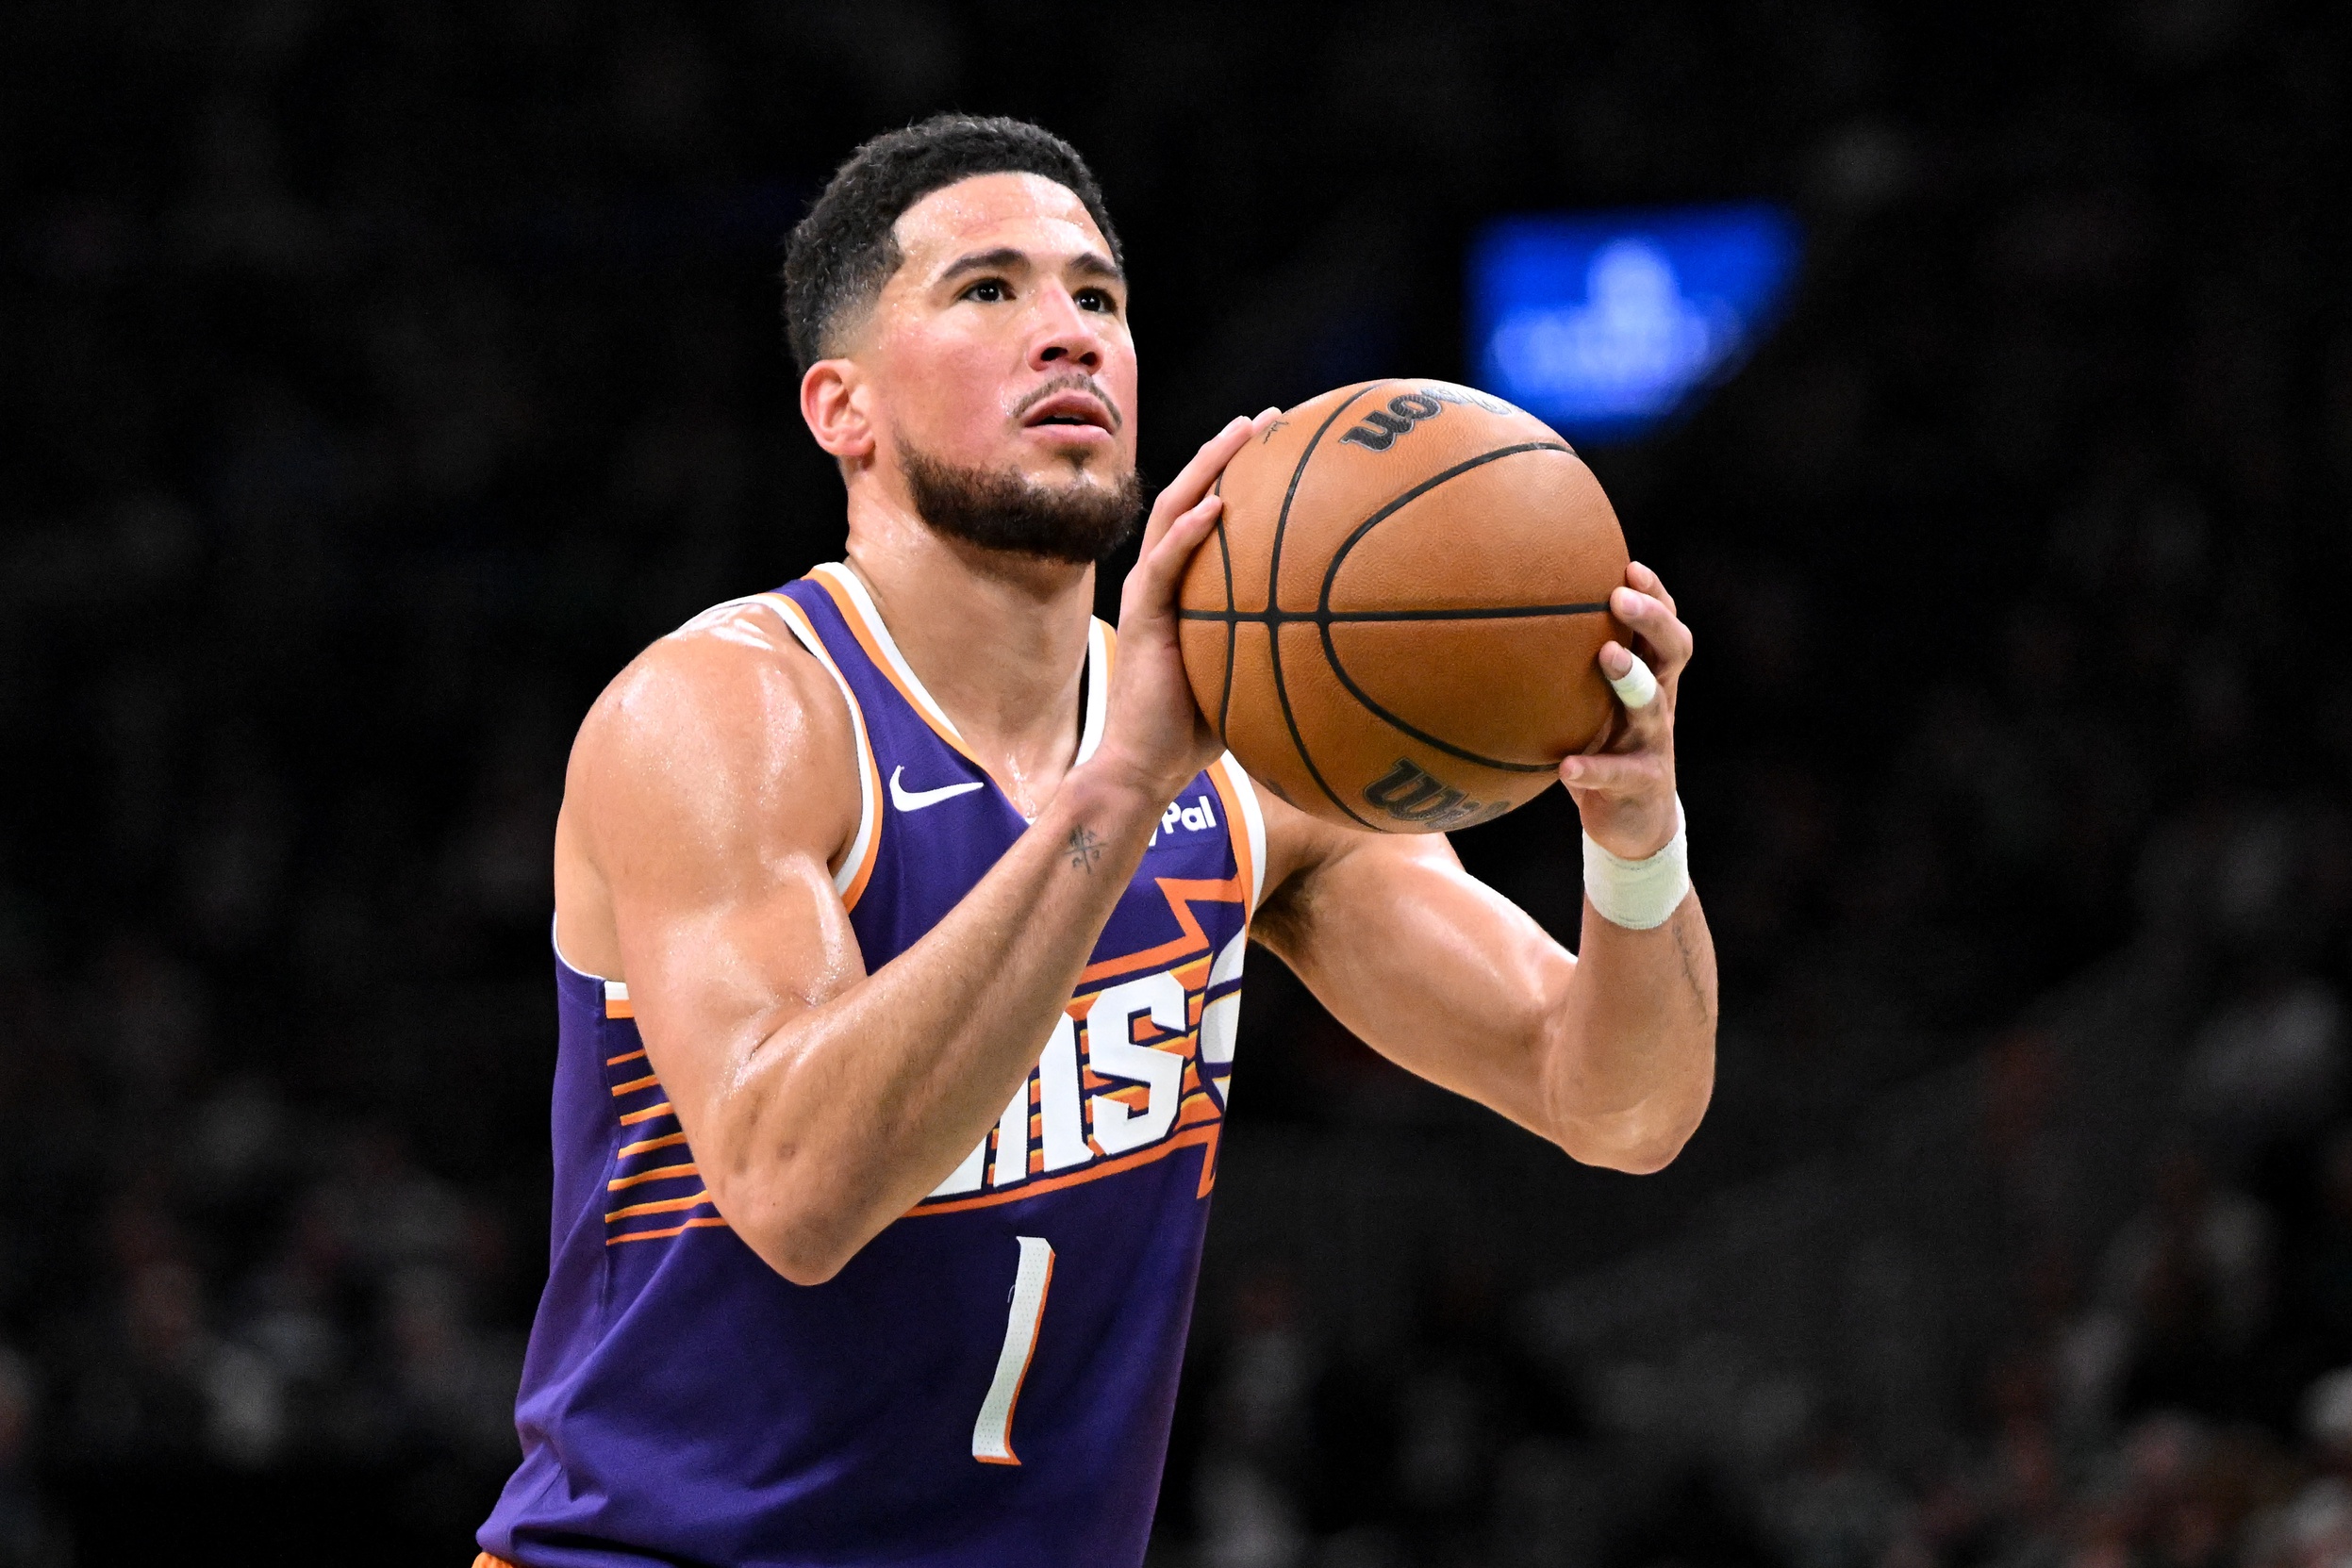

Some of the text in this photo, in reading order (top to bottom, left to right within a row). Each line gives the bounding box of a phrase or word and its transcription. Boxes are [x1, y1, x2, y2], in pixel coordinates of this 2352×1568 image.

[1148, 795, 1217, 847] Pal
[925, 970, 1187, 1197] NS
[971, 1235, 1056, 1466] 1
